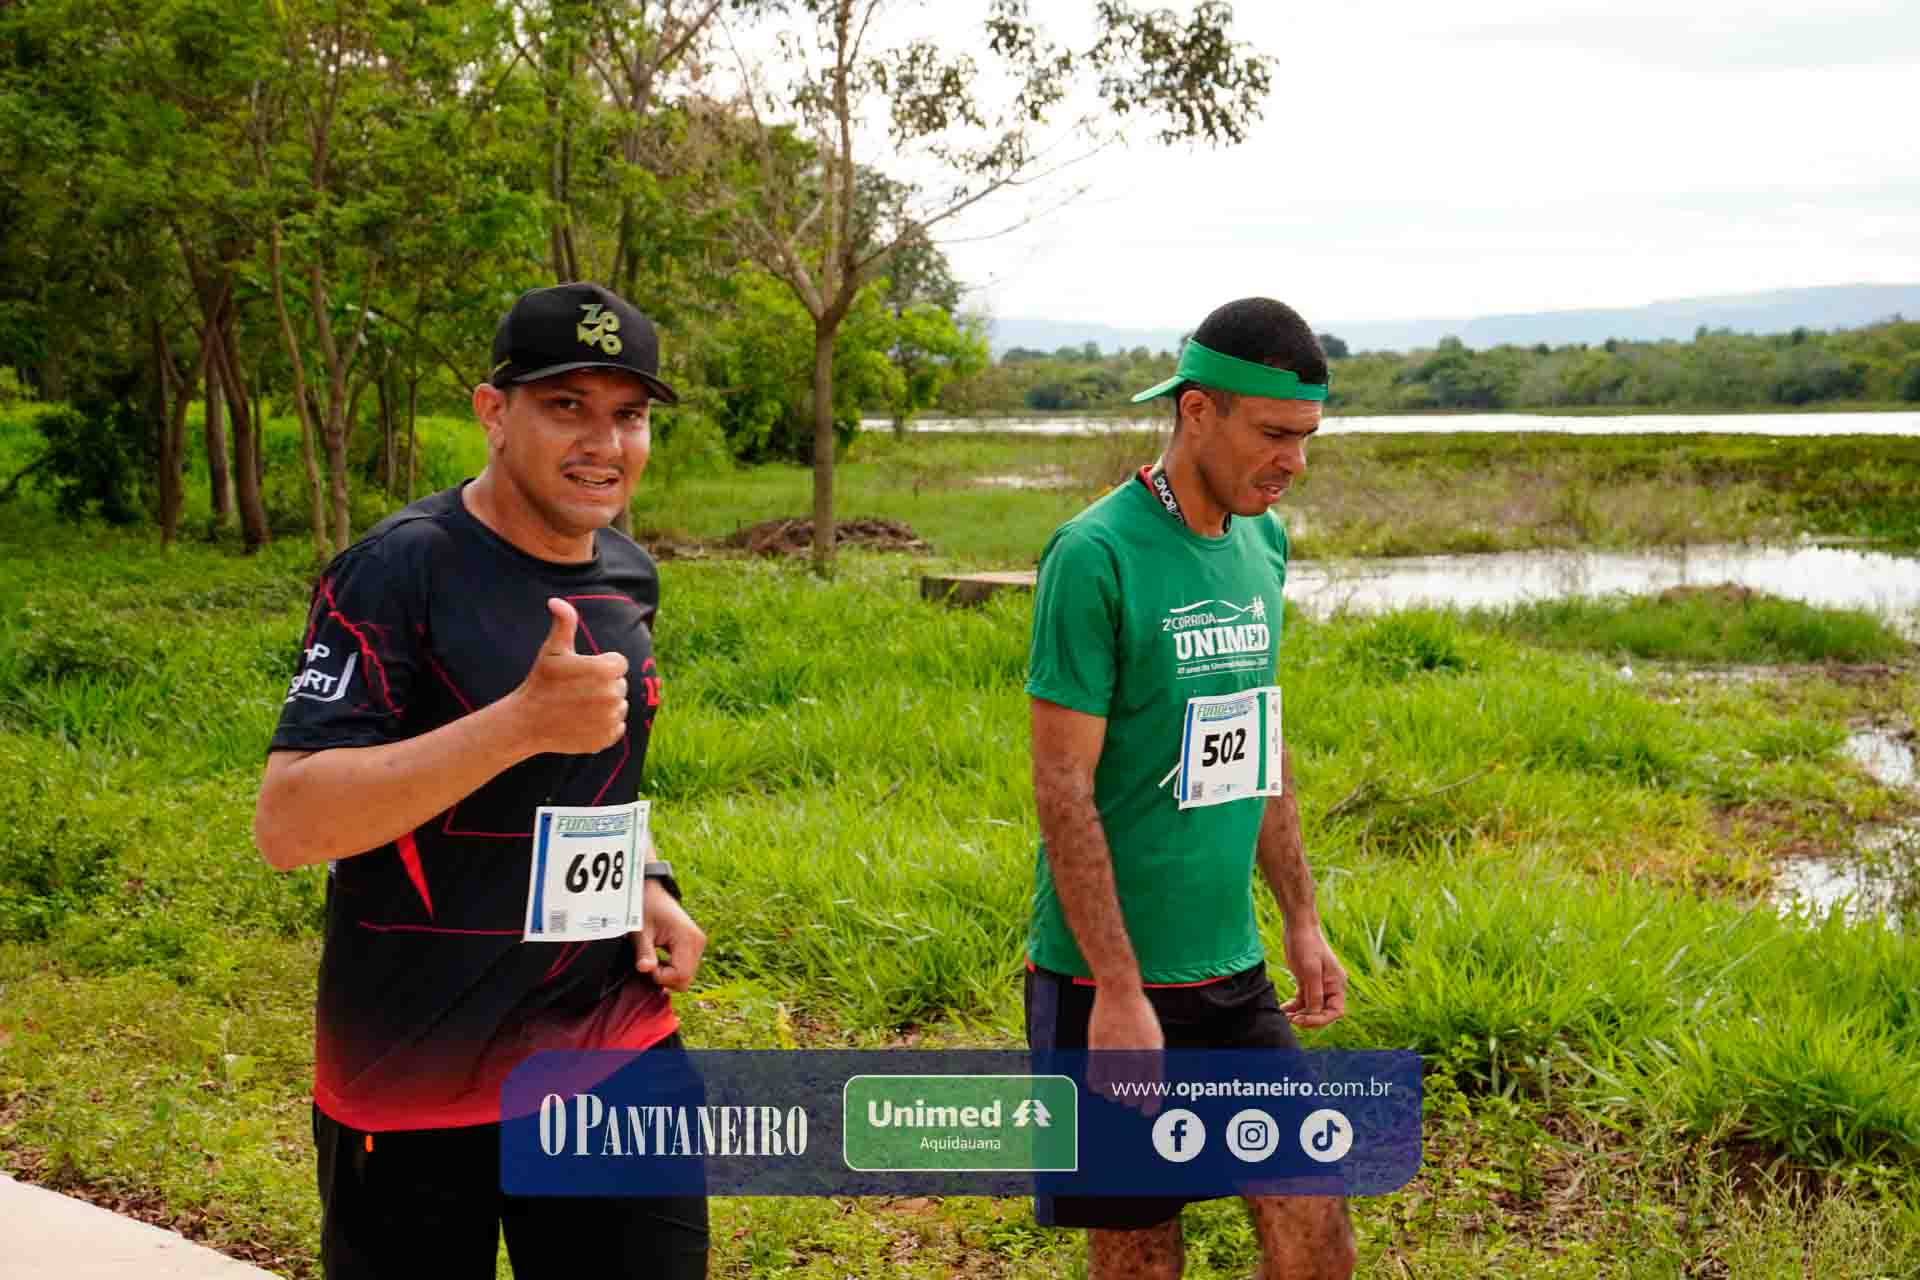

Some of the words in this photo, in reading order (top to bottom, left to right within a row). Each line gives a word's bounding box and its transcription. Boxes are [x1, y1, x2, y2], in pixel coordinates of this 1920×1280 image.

[1172, 612, 1217, 630] CORRIDA
[1173, 623, 1271, 660] UNIMED
[1201, 727, 1247, 768] 502
[565, 849, 624, 894] 698
